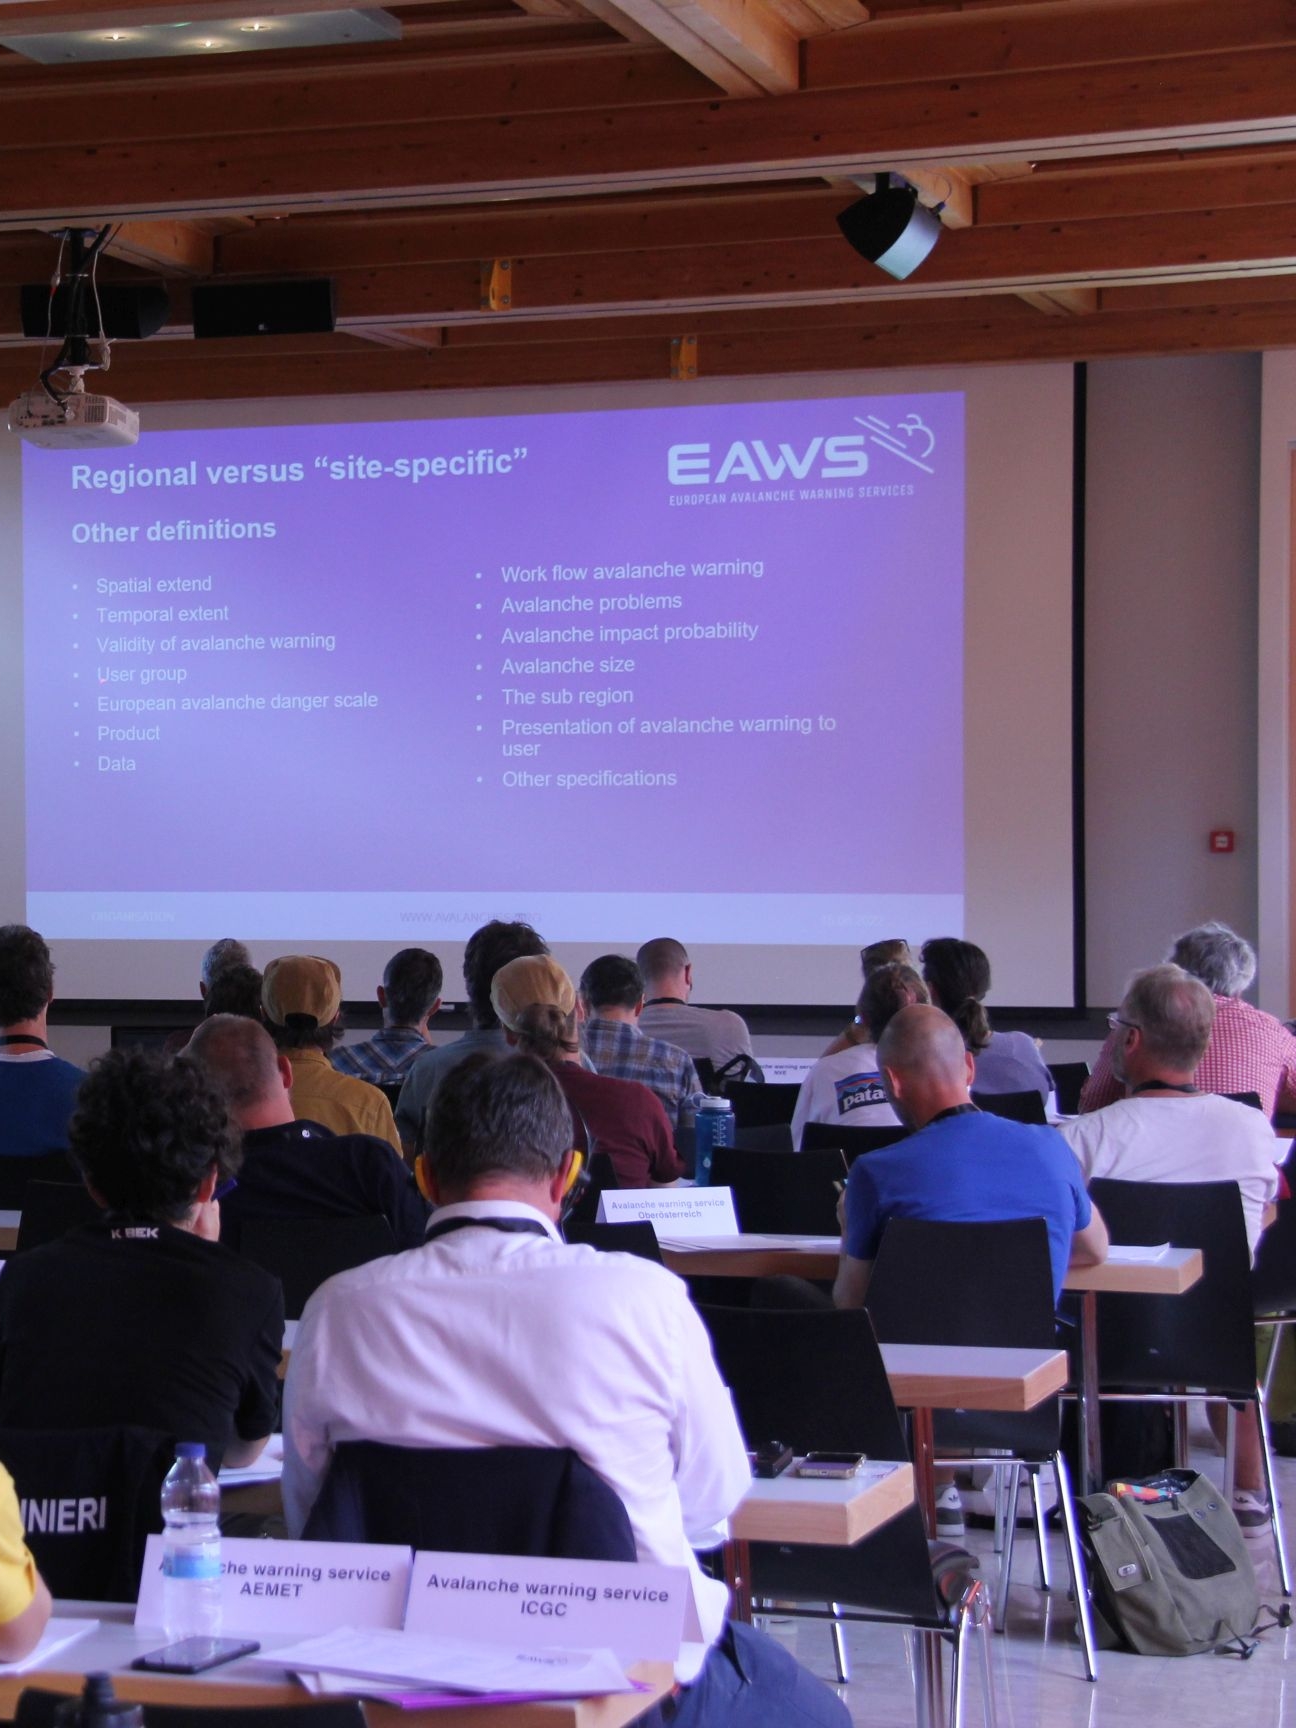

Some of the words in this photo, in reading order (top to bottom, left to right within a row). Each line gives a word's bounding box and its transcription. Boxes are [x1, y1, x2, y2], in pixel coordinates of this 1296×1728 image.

[71, 461, 197, 495] Regional
[206, 462, 305, 485] versus
[314, 447, 528, 484] “site-specific”
[667, 435, 869, 486] EAWS
[668, 493, 727, 506] EUROPEAN
[730, 490, 796, 504] AVALANCHE
[799, 487, 855, 501] WARNING
[858, 484, 915, 498] SERVICES
[71, 522, 140, 544] Other
[146, 518, 277, 542] definitions
[501, 564, 548, 583] Work
[552, 564, 588, 581] flow
[593, 561, 686, 580] avalanche
[690, 558, 764, 578] warning
[96, 577, 152, 597] Spatial
[156, 575, 212, 592] extend
[501, 595, 594, 613] Avalanche
[599, 593, 683, 614] problems
[96, 606, 173, 625] Temporal
[178, 605, 229, 622] extent
[96, 636, 155, 655] Validity
[160, 635, 177, 652] of
[181, 634, 266, 652] avalanche
[270, 632, 336, 652] warning
[501, 625, 594, 644] Avalanche
[599, 624, 659, 645] impact
[664, 621, 759, 643] probability
[97, 666, 136, 682] User
[140, 667, 188, 685] group
[501, 656, 594, 674] Avalanche
[599, 656, 635, 673] size
[97, 695, 177, 714] European
[181, 694, 266, 711] avalanche
[270, 693, 329, 712] danger
[334, 692, 379, 708] scale
[502, 688, 536, 705] The
[541, 688, 573, 705] sub
[579, 687, 634, 707] region
[98, 725, 161, 741] Product
[502, 717, 613, 735] Presentation
[618, 717, 636, 734] of
[640, 716, 734, 734] avalanche
[739, 715, 812, 735] warning
[818, 715, 837, 731] to
[502, 742, 541, 757] user
[98, 755, 137, 772] Data
[502, 770, 553, 788] Other
[556, 769, 678, 790] specifications
[611, 1201, 656, 1209] Avalanche
[658, 1199, 692, 1209] warning
[694, 1199, 725, 1207] service
[638, 1210, 702, 1219] Oberösterreich
[20, 1496, 107, 1534] INIERI
[254, 1561, 322, 1581] warning
[328, 1564, 392, 1582] service
[240, 1581, 304, 1598] AEMET
[427, 1574, 520, 1594] Avalanche
[525, 1581, 597, 1601] warning
[603, 1585, 669, 1602] service
[520, 1600, 568, 1617] ICGC
